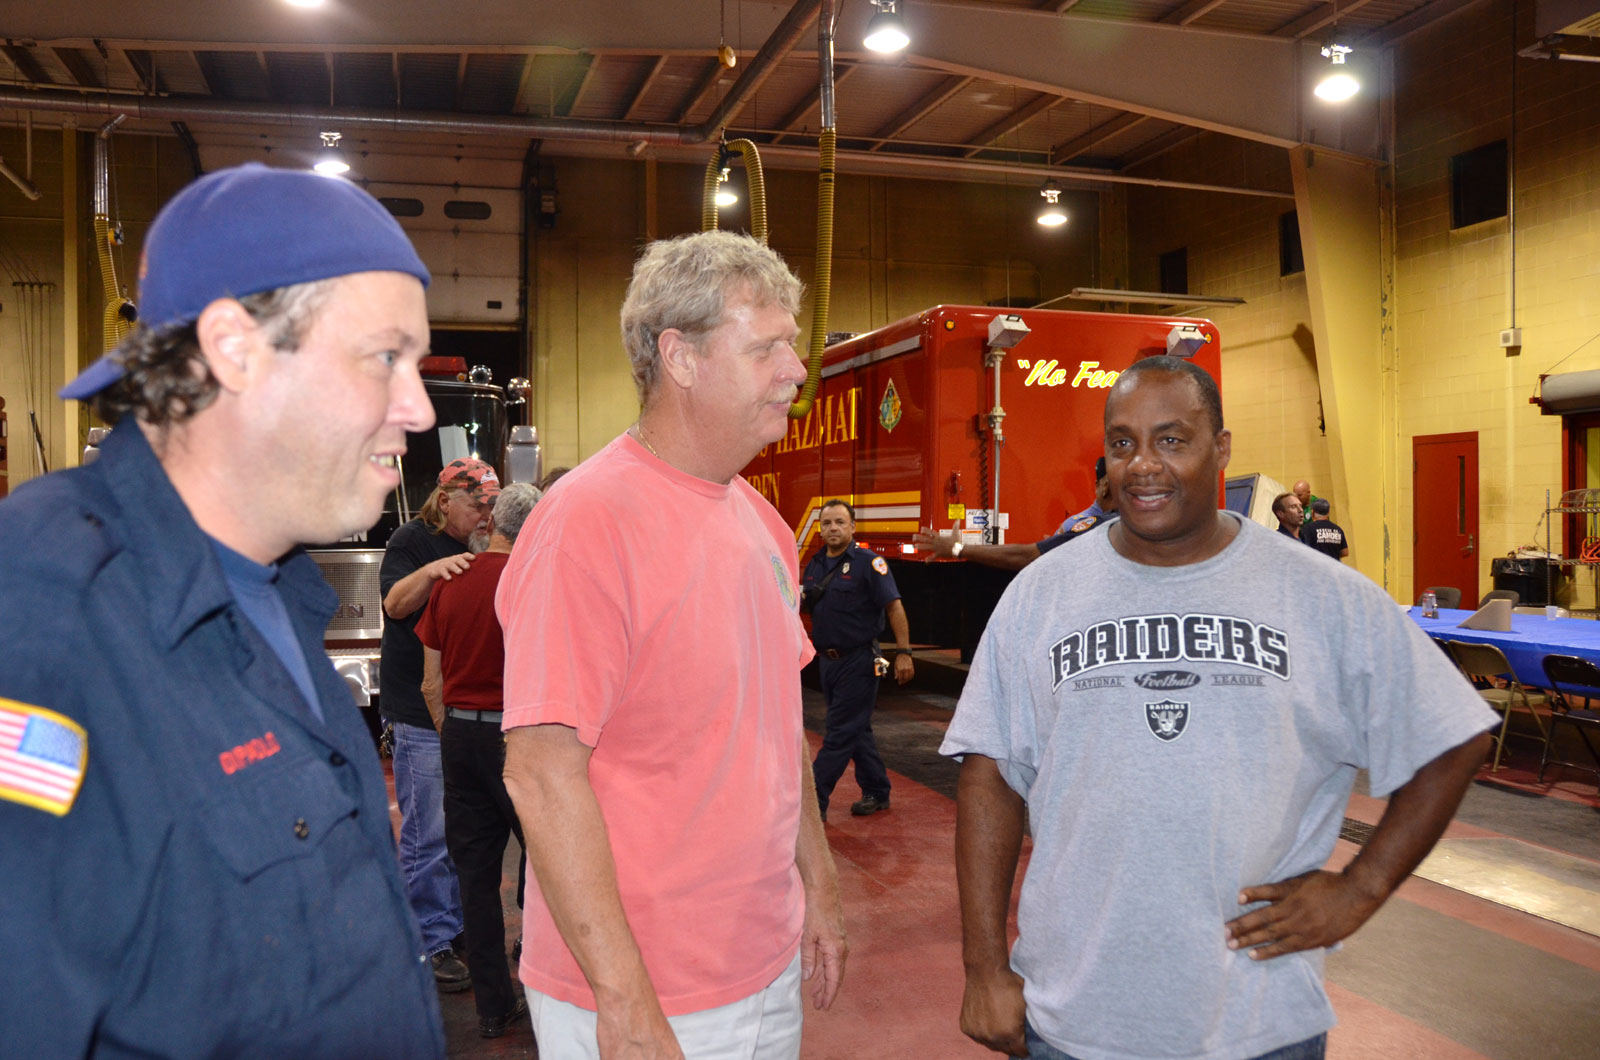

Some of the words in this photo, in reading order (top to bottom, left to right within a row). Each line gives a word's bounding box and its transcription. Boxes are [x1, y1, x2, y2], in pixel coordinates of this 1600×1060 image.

[1071, 361, 1127, 388] Fea
[1049, 613, 1292, 694] RAIDERS
[1074, 677, 1122, 690] NATIONAL
[1137, 671, 1197, 689] Football
[1214, 675, 1263, 686] LEAGUE
[1149, 703, 1186, 711] RAIDERS
